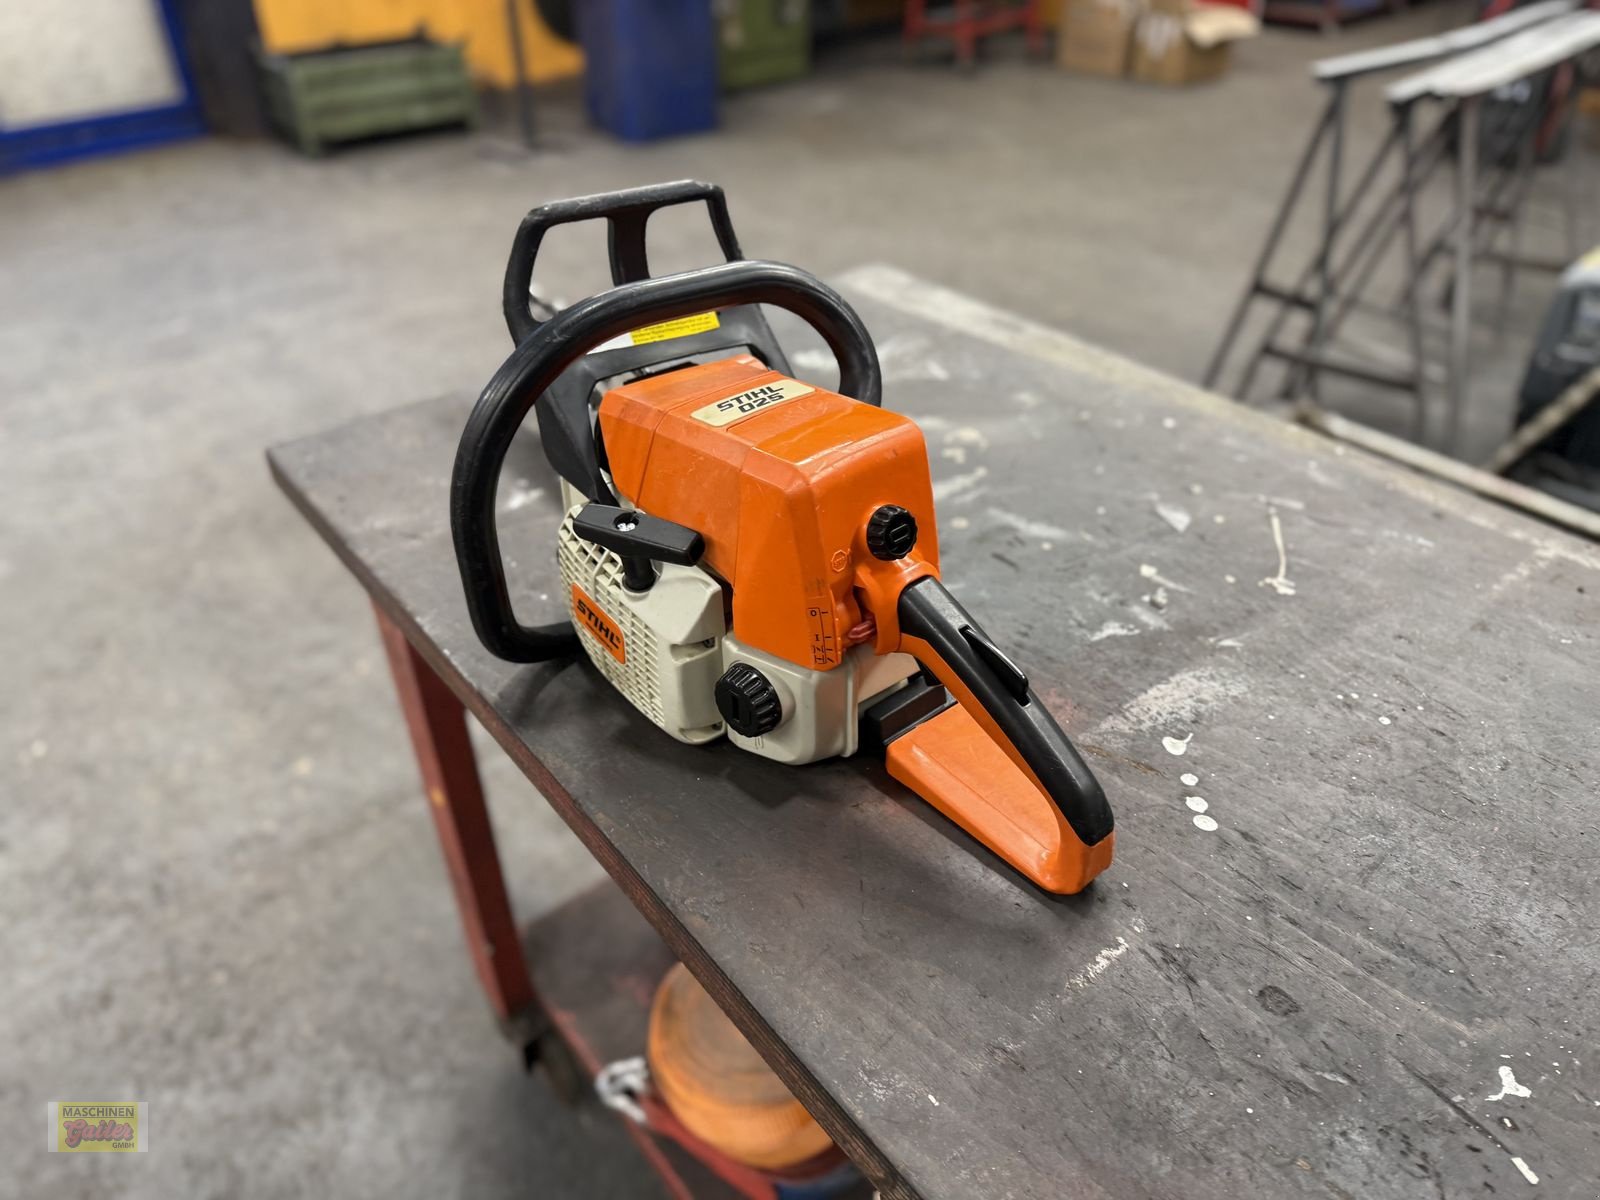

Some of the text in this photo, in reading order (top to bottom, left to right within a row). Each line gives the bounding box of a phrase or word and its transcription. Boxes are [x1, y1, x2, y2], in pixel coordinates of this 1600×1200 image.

[716, 386, 784, 412] STIHL
[738, 392, 785, 413] 025
[577, 598, 620, 650] STIHL
